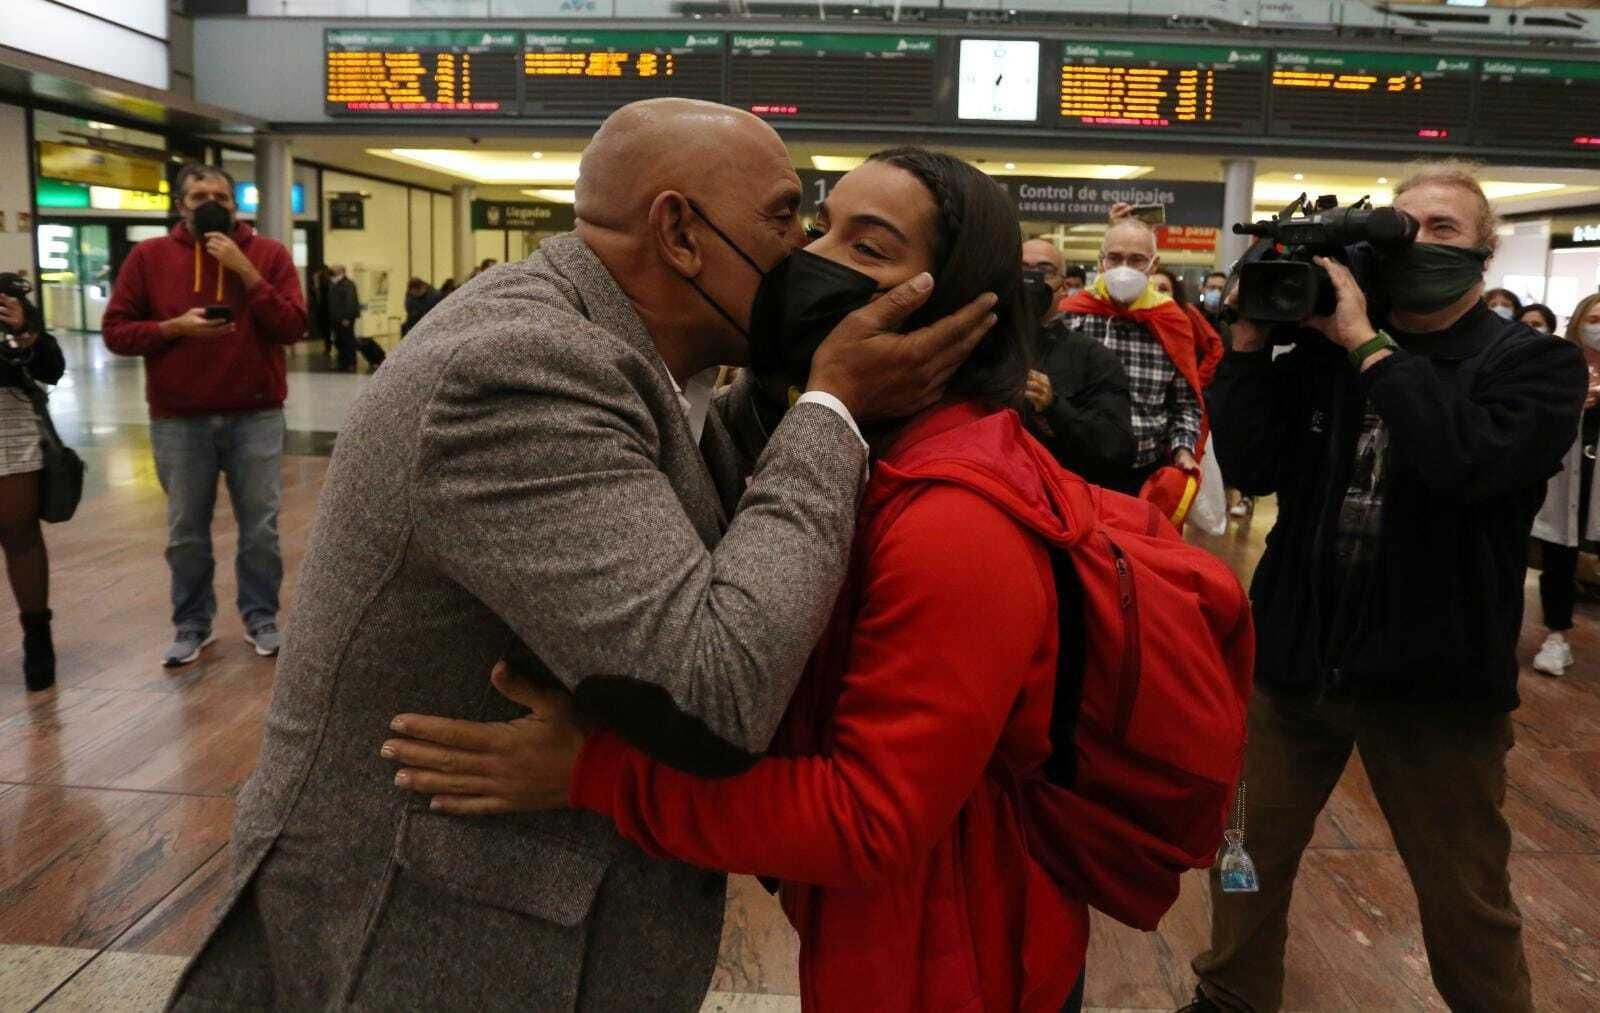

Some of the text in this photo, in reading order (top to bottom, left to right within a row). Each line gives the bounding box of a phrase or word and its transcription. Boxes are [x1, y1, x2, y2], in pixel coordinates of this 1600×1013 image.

[733, 36, 775, 48] Llegadas
[1019, 183, 1175, 205] Control de equipajes
[505, 207, 552, 220] Llegadas
[1018, 202, 1110, 214] LUGGAGE CONTRO
